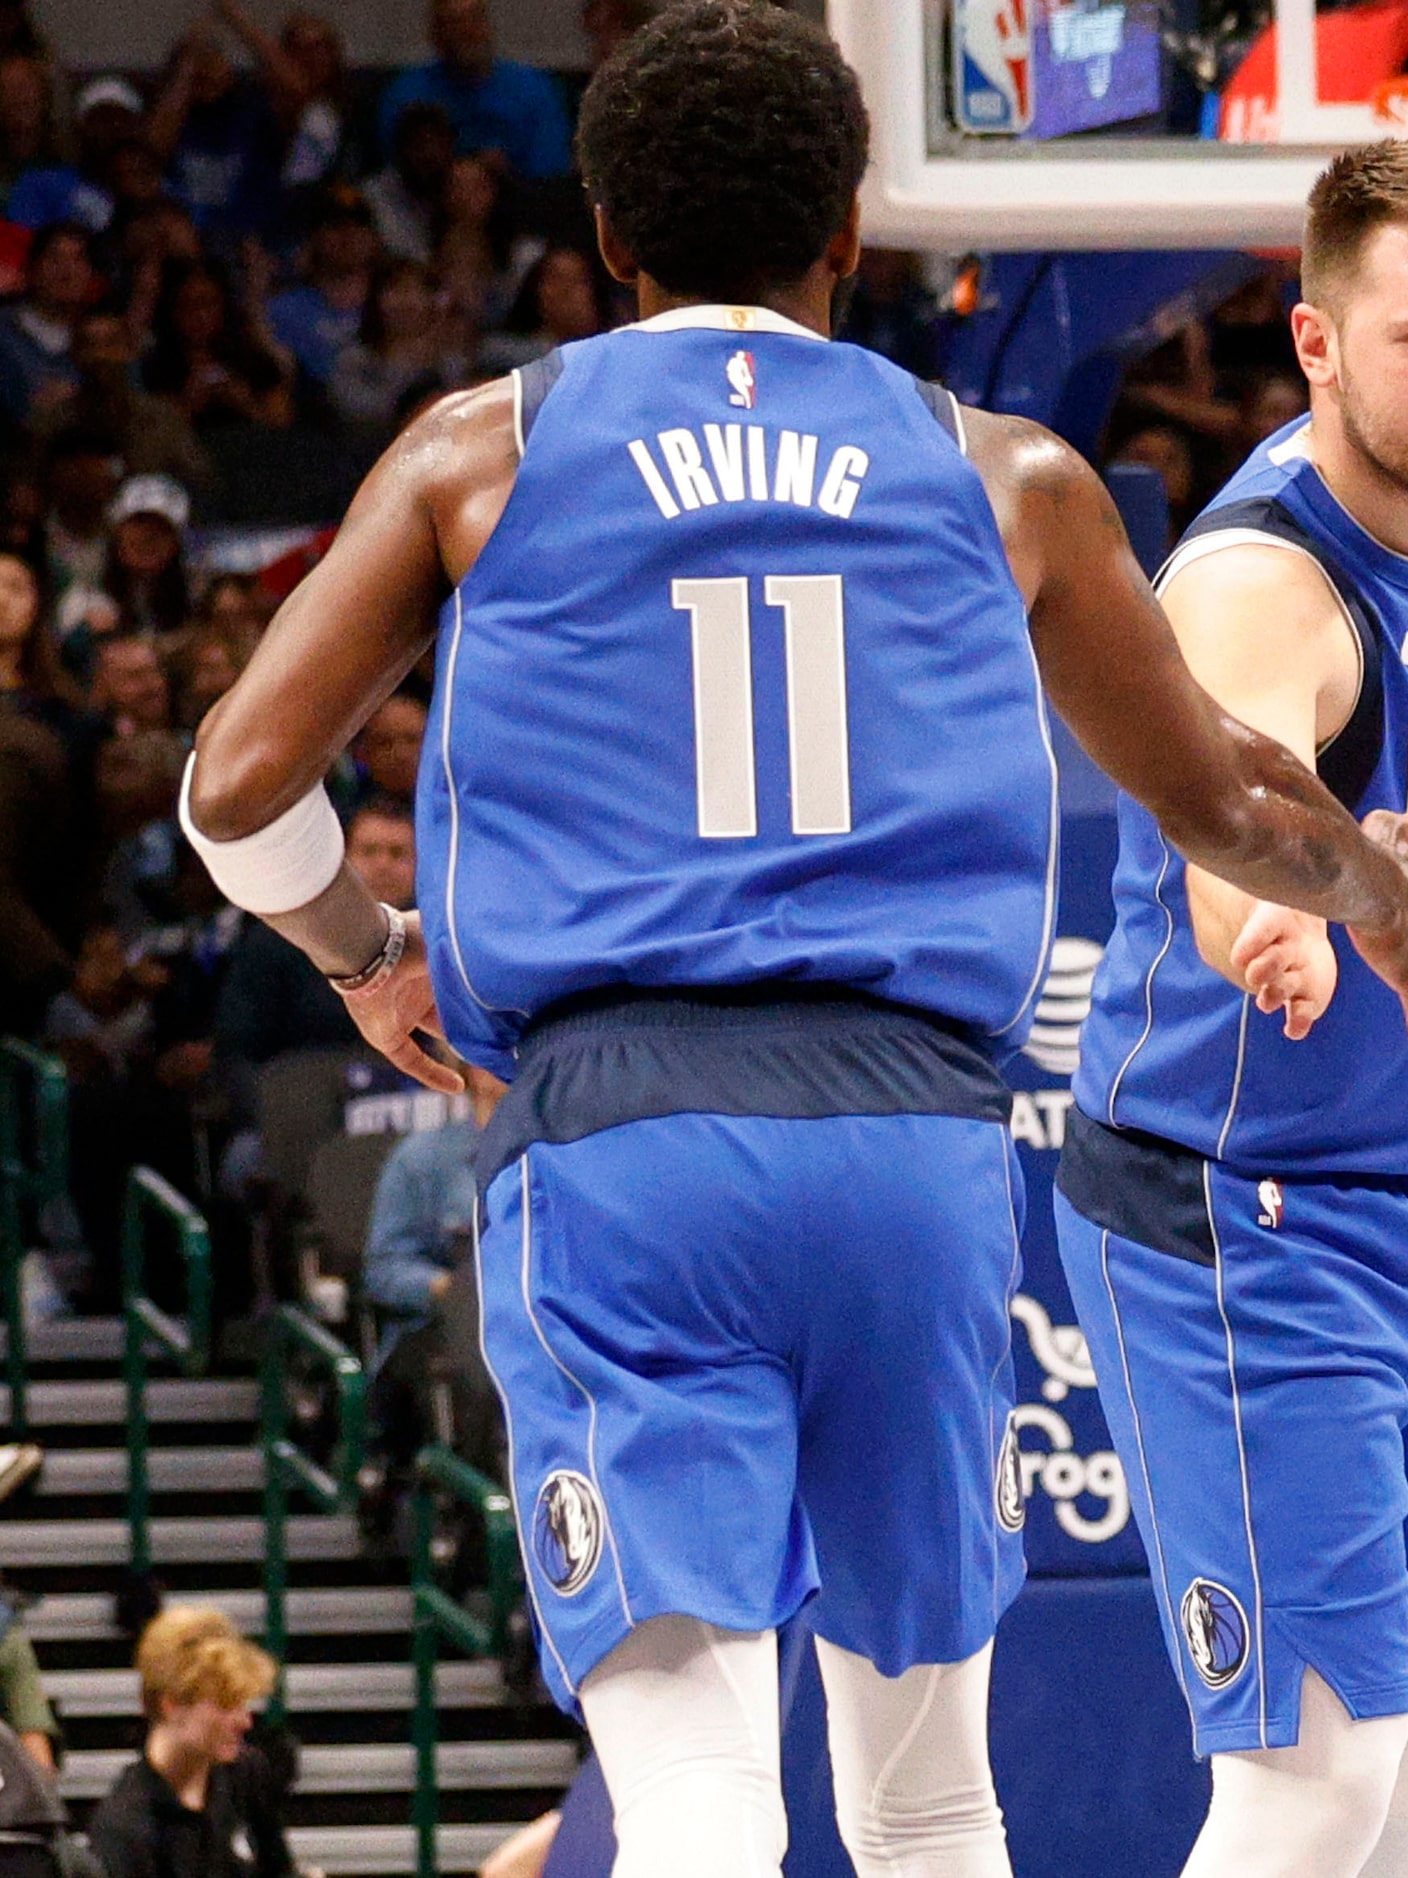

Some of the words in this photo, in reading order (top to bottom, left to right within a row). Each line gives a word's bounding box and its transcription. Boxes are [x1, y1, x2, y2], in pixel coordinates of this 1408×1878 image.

[627, 423, 870, 519] IRVING
[671, 574, 851, 838] 11
[1010, 1089, 1075, 1150] AT
[1014, 1403, 1130, 1543] rog
